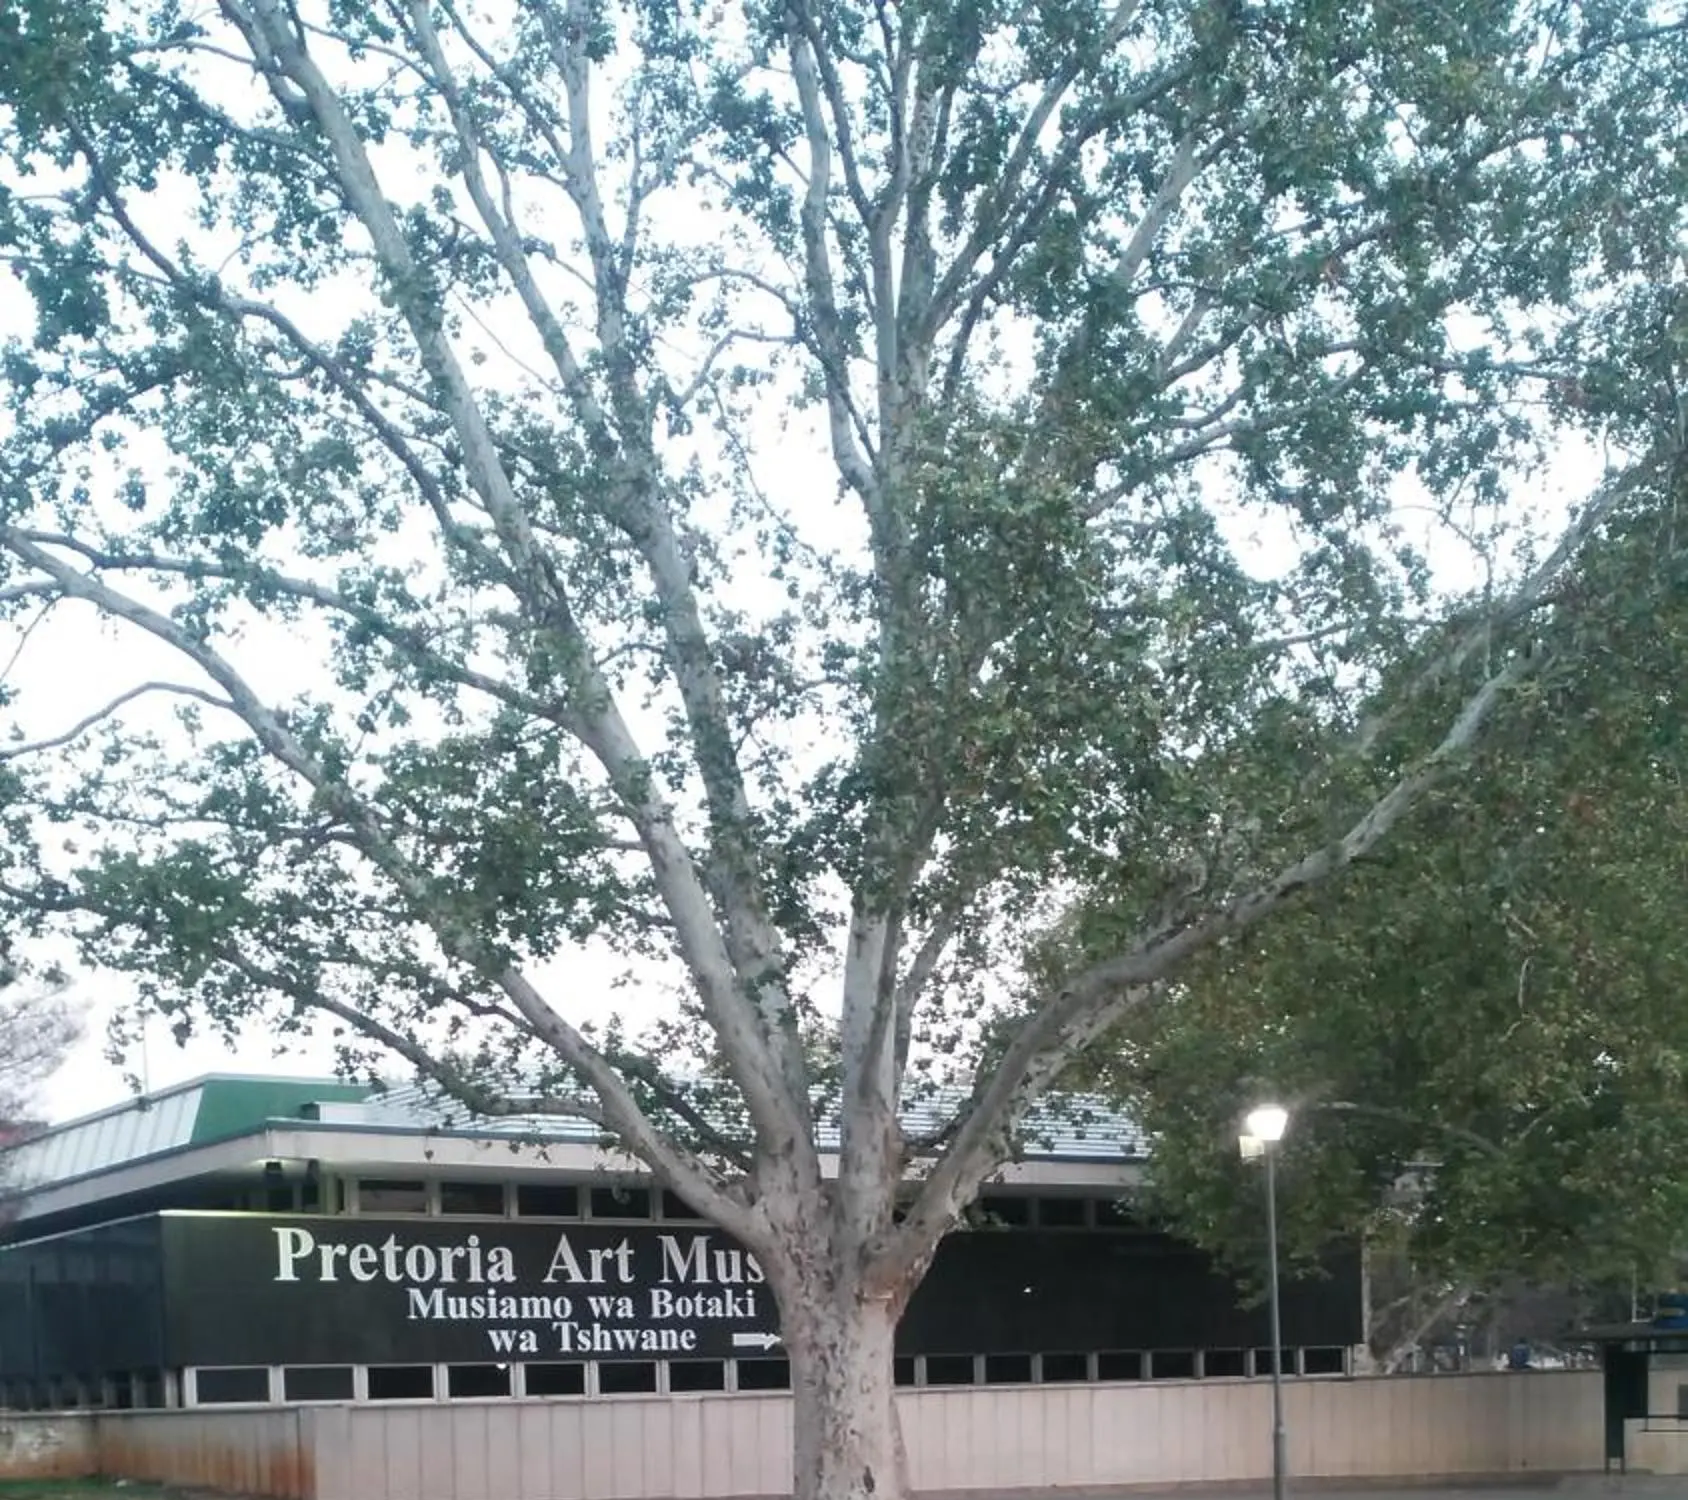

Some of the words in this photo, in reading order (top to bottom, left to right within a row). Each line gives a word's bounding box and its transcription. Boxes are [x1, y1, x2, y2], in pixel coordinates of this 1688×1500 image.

[272, 1226, 516, 1283] Pretoria
[543, 1234, 634, 1284] Art
[407, 1288, 572, 1320] Musiamo
[588, 1294, 634, 1318] wa
[650, 1288, 757, 1318] Botaki
[488, 1327, 538, 1352] wa
[553, 1321, 697, 1351] Tshwane
